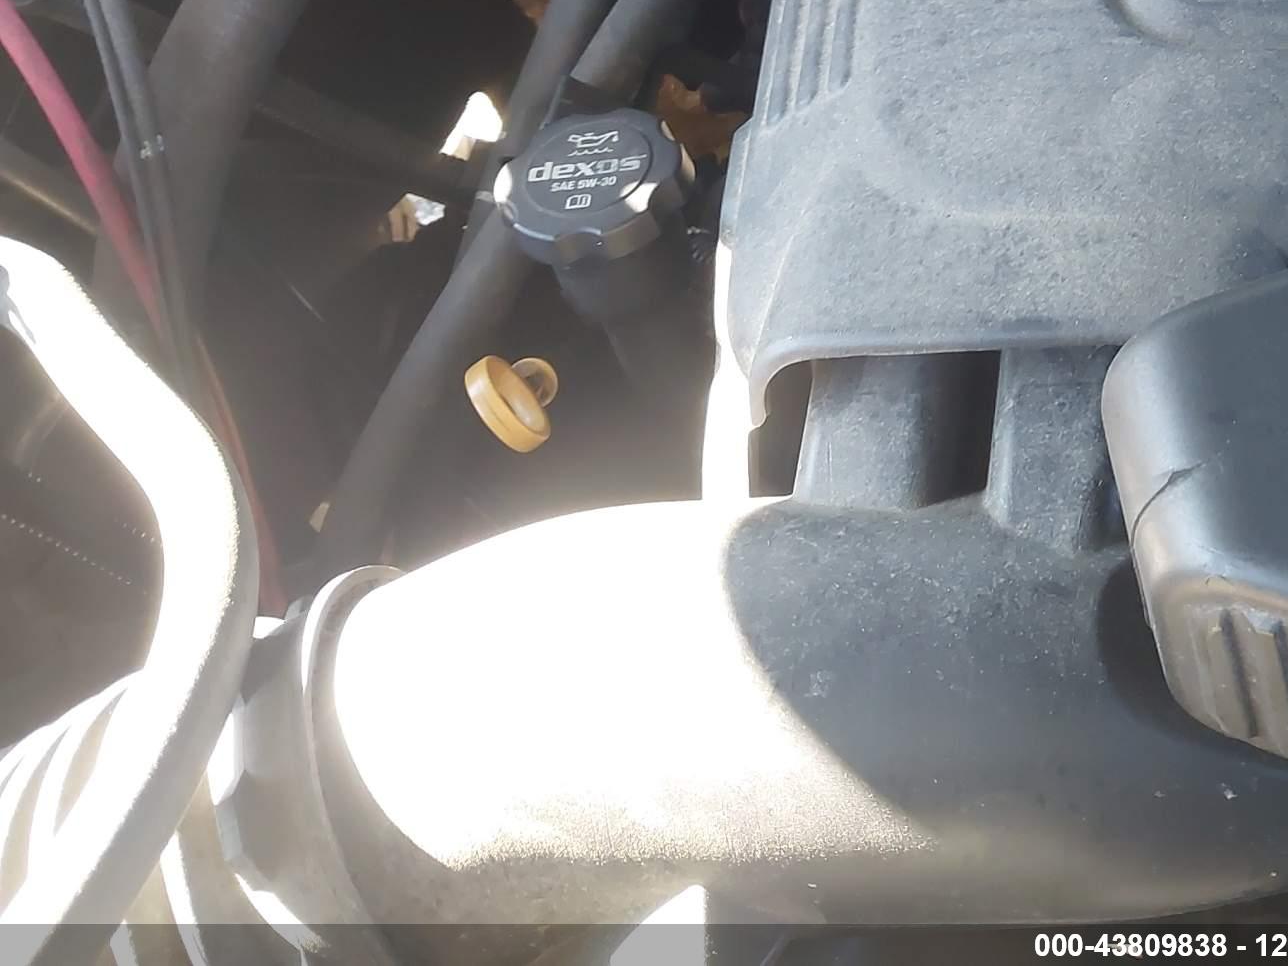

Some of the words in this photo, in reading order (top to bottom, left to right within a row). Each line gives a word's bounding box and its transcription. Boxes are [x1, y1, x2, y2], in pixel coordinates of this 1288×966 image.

[528, 154, 647, 182] dexos
[551, 180, 575, 192] SAE
[577, 176, 617, 189] 5W-30
